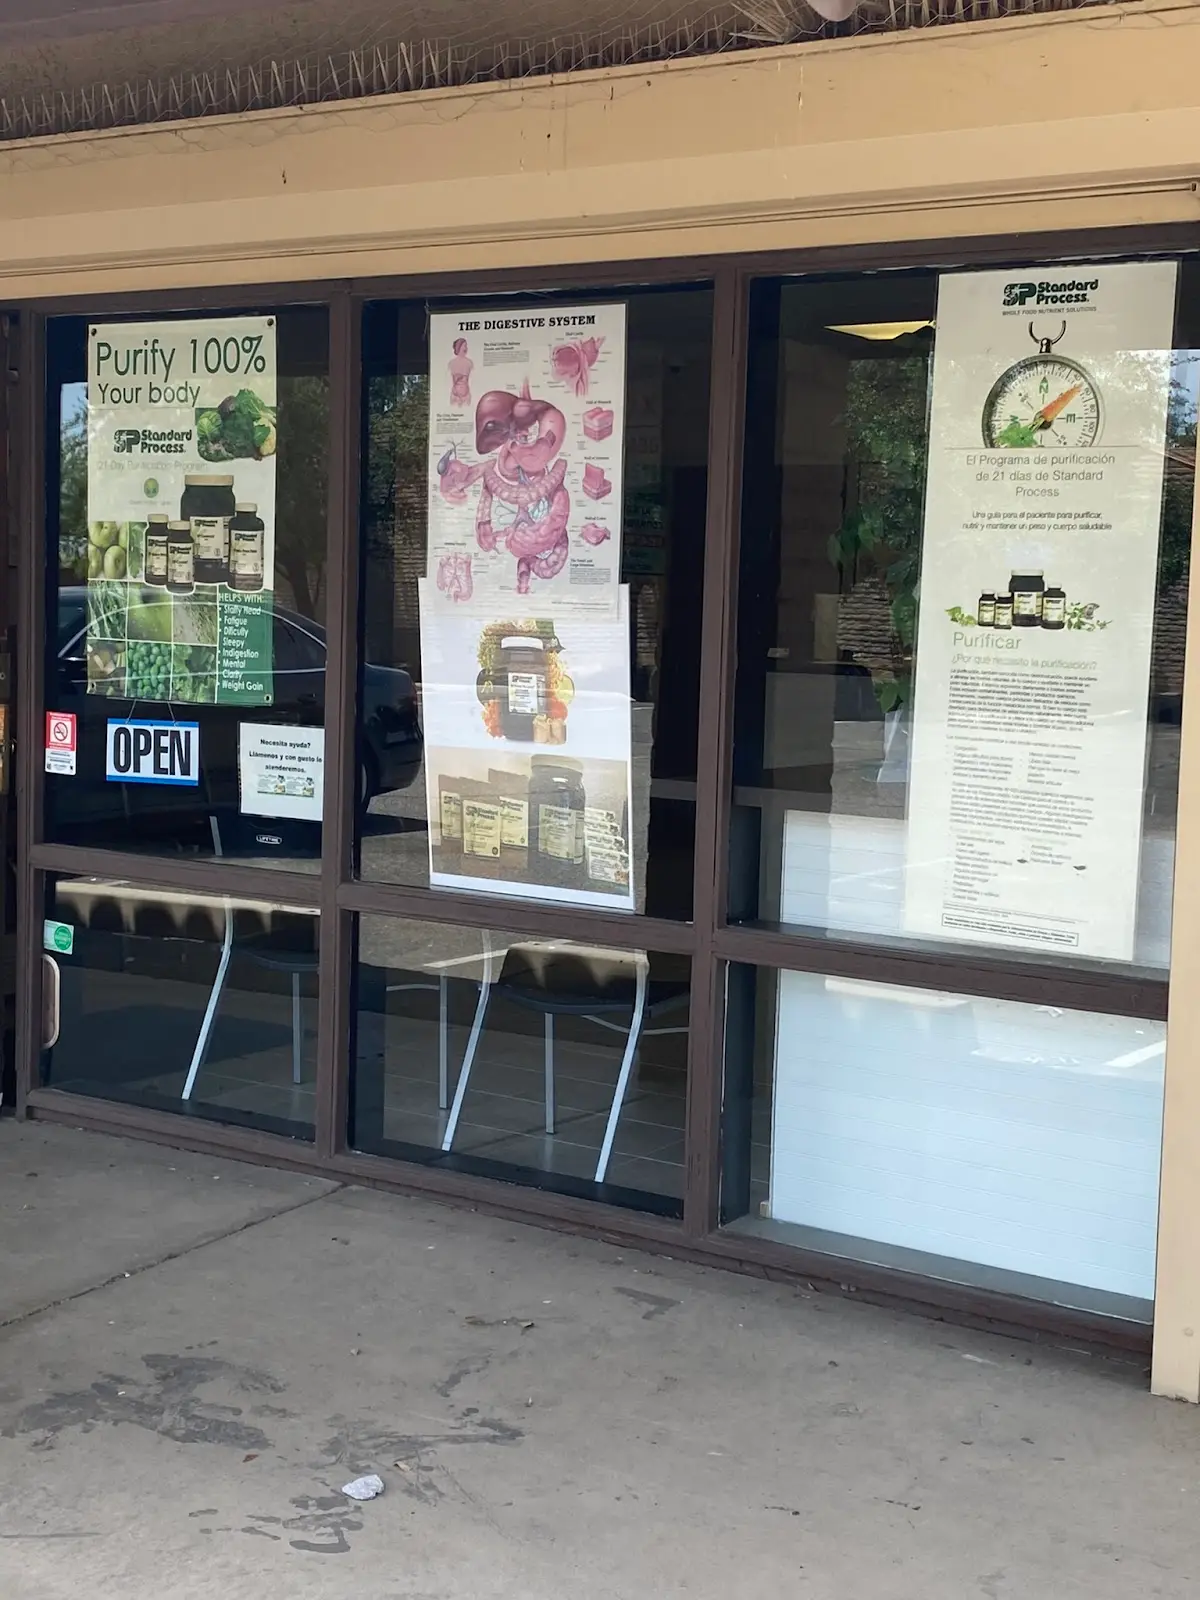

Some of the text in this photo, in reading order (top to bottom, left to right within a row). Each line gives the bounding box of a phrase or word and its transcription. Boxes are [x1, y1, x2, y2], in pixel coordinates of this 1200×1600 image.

[1037, 279, 1099, 293] Standard
[458, 315, 596, 331] THE DIGESTIVE SYSTEM
[96, 335, 266, 383] Purify 100%
[98, 381, 201, 407] Your body
[1039, 382, 1049, 394] N
[1066, 413, 1076, 423] E
[141, 429, 192, 441] Standard
[966, 453, 1115, 467] El Programa de purificación
[976, 471, 989, 481] de
[992, 471, 1005, 481] 21
[1035, 470, 1049, 481] de
[1052, 470, 1103, 481] Standard
[1015, 486, 1060, 497] Process
[219, 592, 242, 602] HELPS
[224, 615, 248, 627] Fatigue
[223, 636, 245, 649] Sleepy
[953, 631, 1022, 649] Purificar
[222, 648, 259, 659] Indigestion
[222, 659, 246, 668] Mental
[222, 680, 264, 691] Weight Gain
[260, 739, 288, 747] Necesita
[113, 727, 191, 776] OPEN
